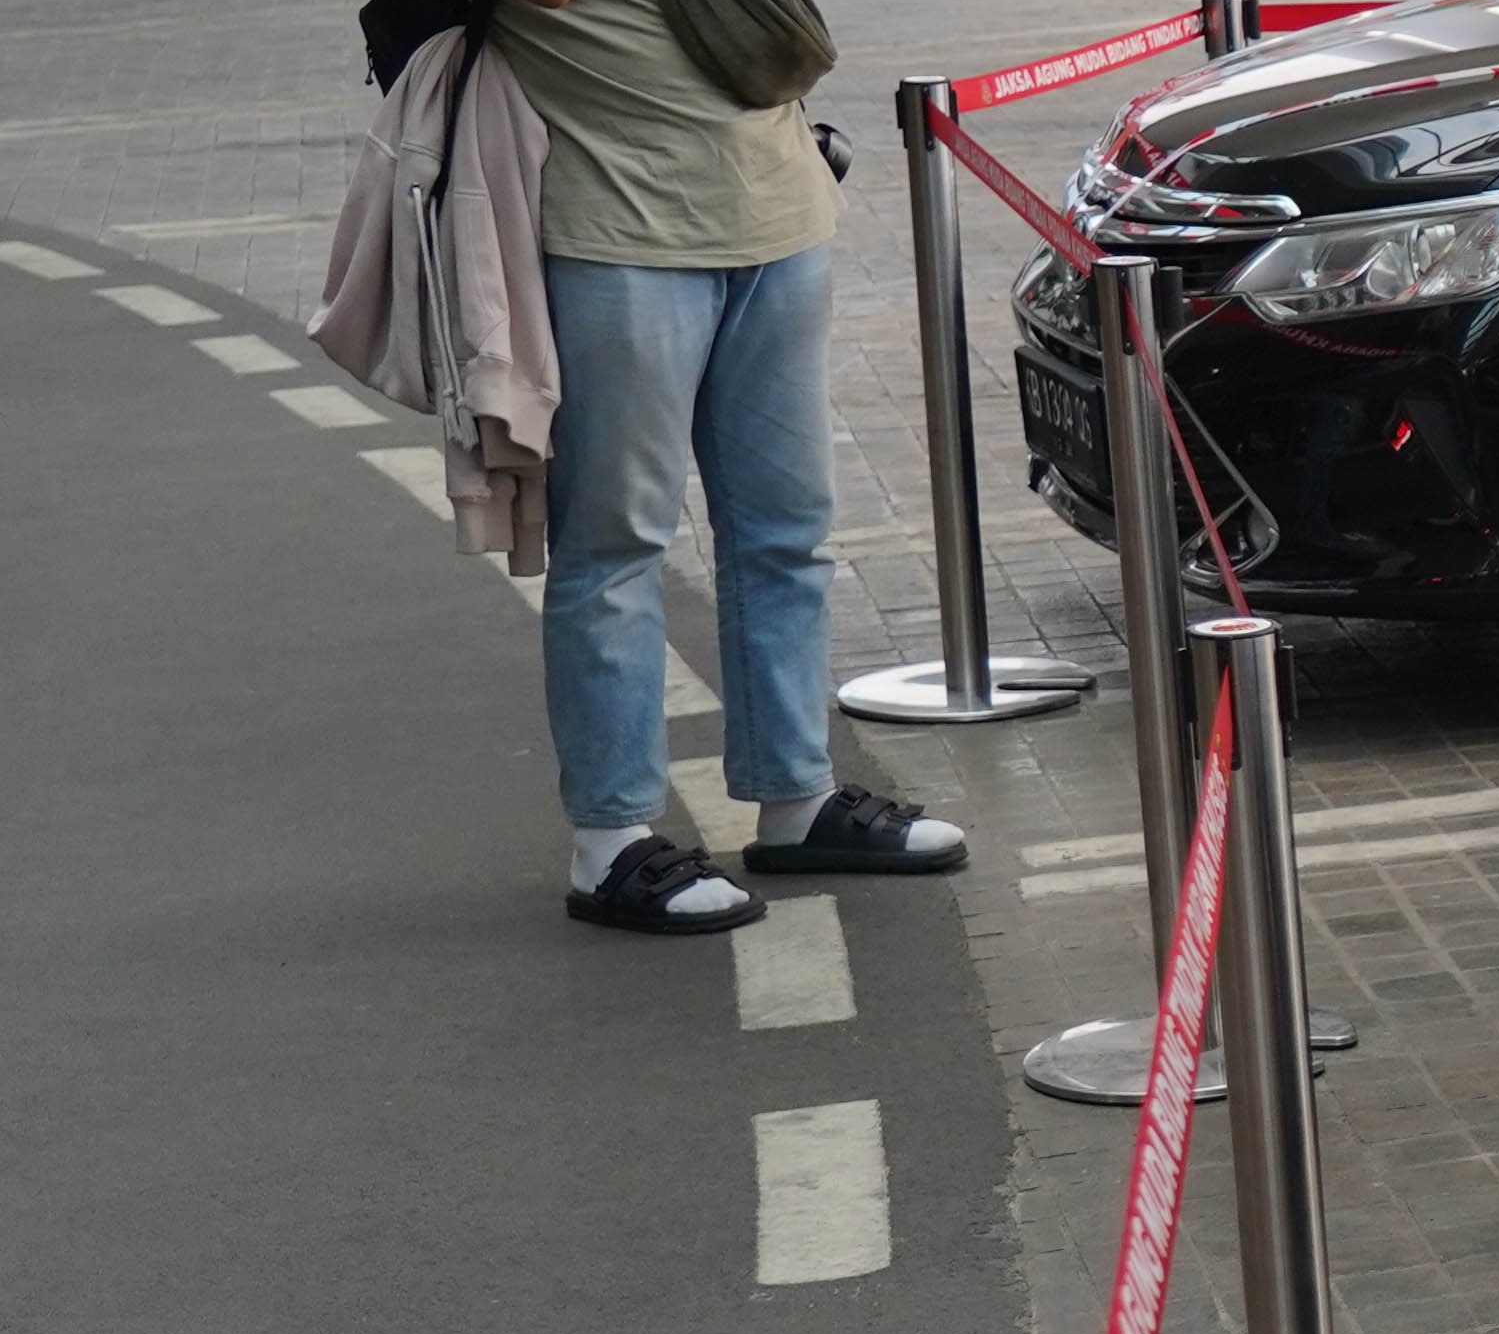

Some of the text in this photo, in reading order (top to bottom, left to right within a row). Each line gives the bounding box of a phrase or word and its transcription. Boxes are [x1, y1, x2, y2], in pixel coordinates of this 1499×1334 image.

[995, 71, 1034, 99] JAKSA
[1034, 57, 1075, 87] AGUNG
[1074, 46, 1109, 75] MUDA
[1108, 33, 1147, 65] BIDANG
[1146, 22, 1184, 50] TINDAK
[1151, 1014, 1196, 1149] BIDANG
